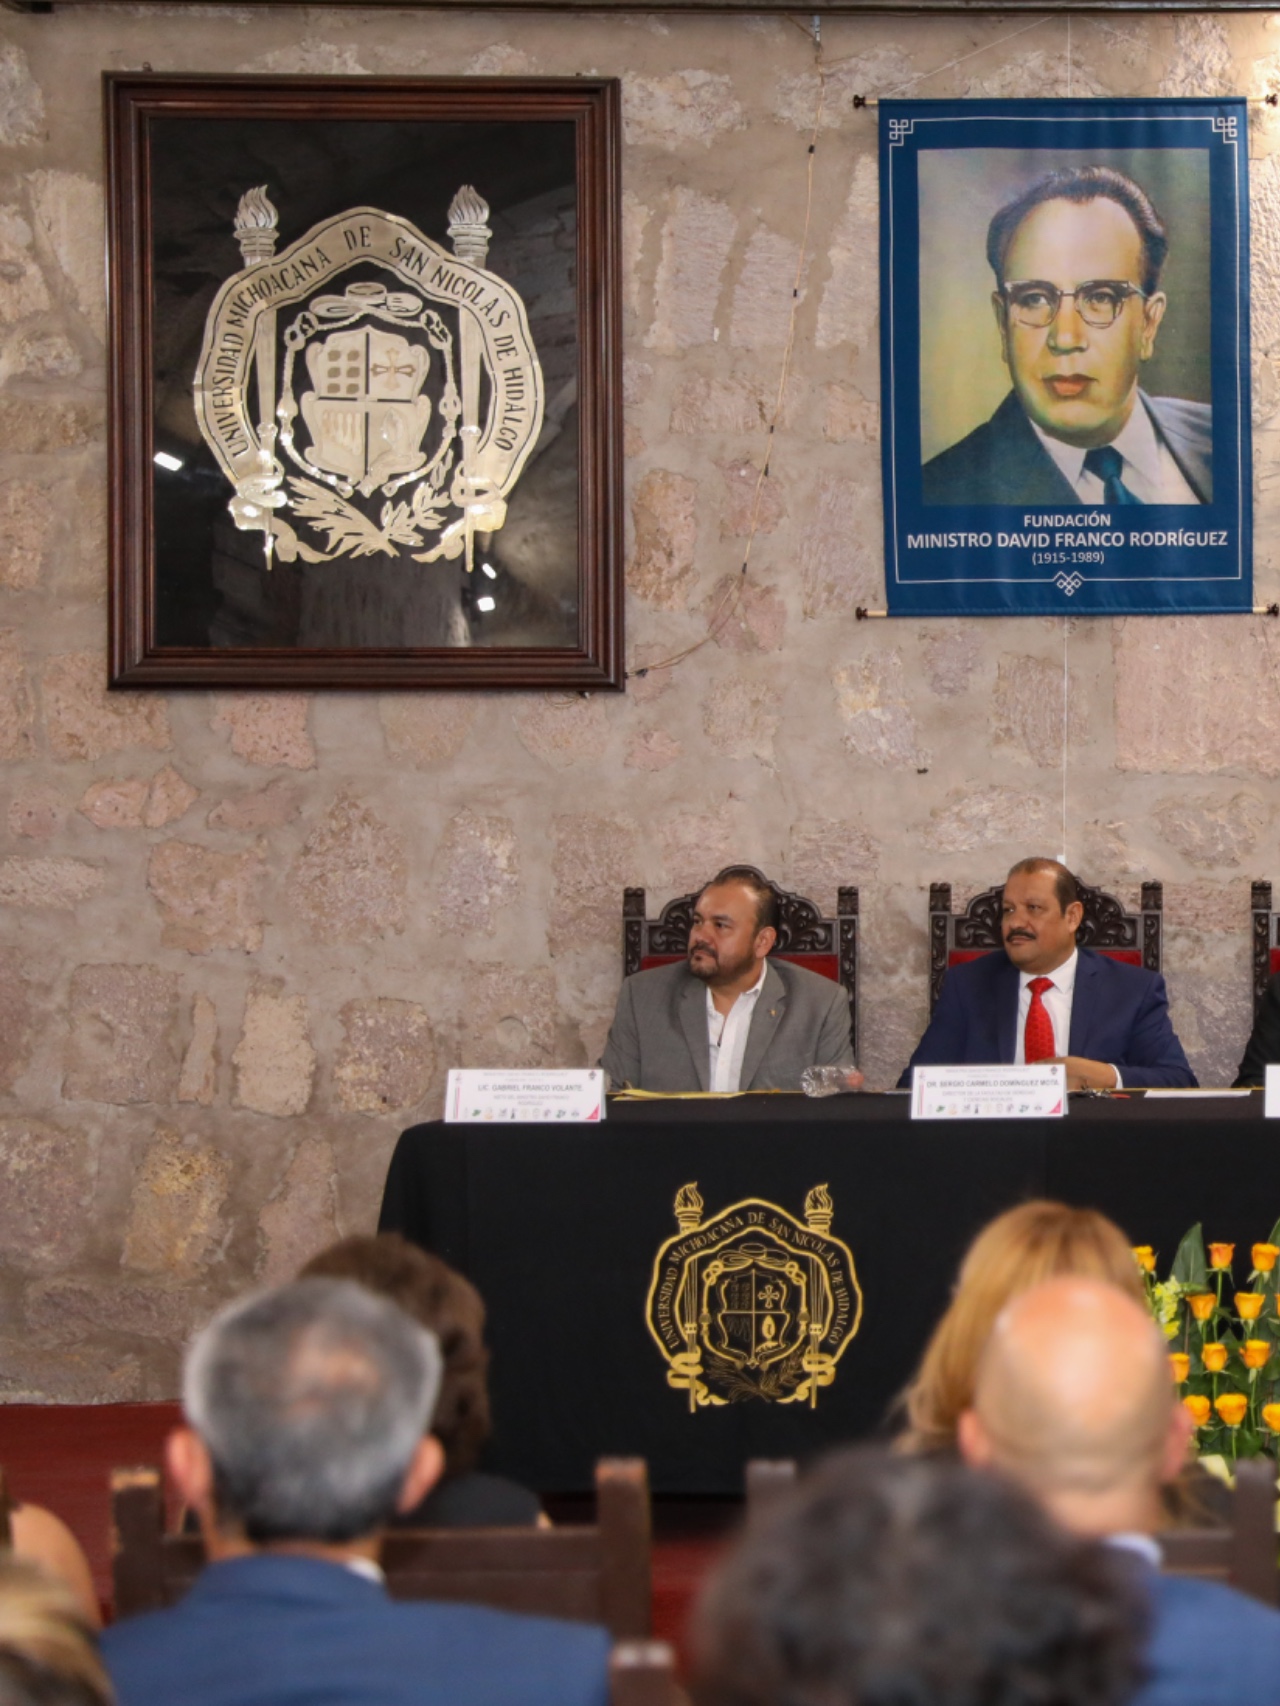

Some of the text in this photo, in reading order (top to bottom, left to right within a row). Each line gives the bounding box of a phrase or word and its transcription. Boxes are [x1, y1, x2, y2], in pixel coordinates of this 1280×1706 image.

[343, 225, 371, 250] DE
[389, 237, 430, 275] SAN
[226, 248, 332, 328] MICHOACANA
[430, 265, 511, 328] NICOLAS
[493, 334, 519, 361] DE
[212, 333, 250, 457] UNIVERSIDAD
[1023, 511, 1111, 528] FUNDACIÓN
[907, 528, 1228, 549] MINISTRO DAVID FRANCO RODRÍGUEZ
[1032, 552, 1105, 565] (1915-1989)
[747, 1211, 766, 1225] DE
[768, 1217, 790, 1239] SAN
[669, 1216, 744, 1266] MICHOACANA
[791, 1230, 841, 1268] NICOLAS
[830, 1270, 844, 1288] DE
[658, 1268, 681, 1349] UNIVERSIDAD
